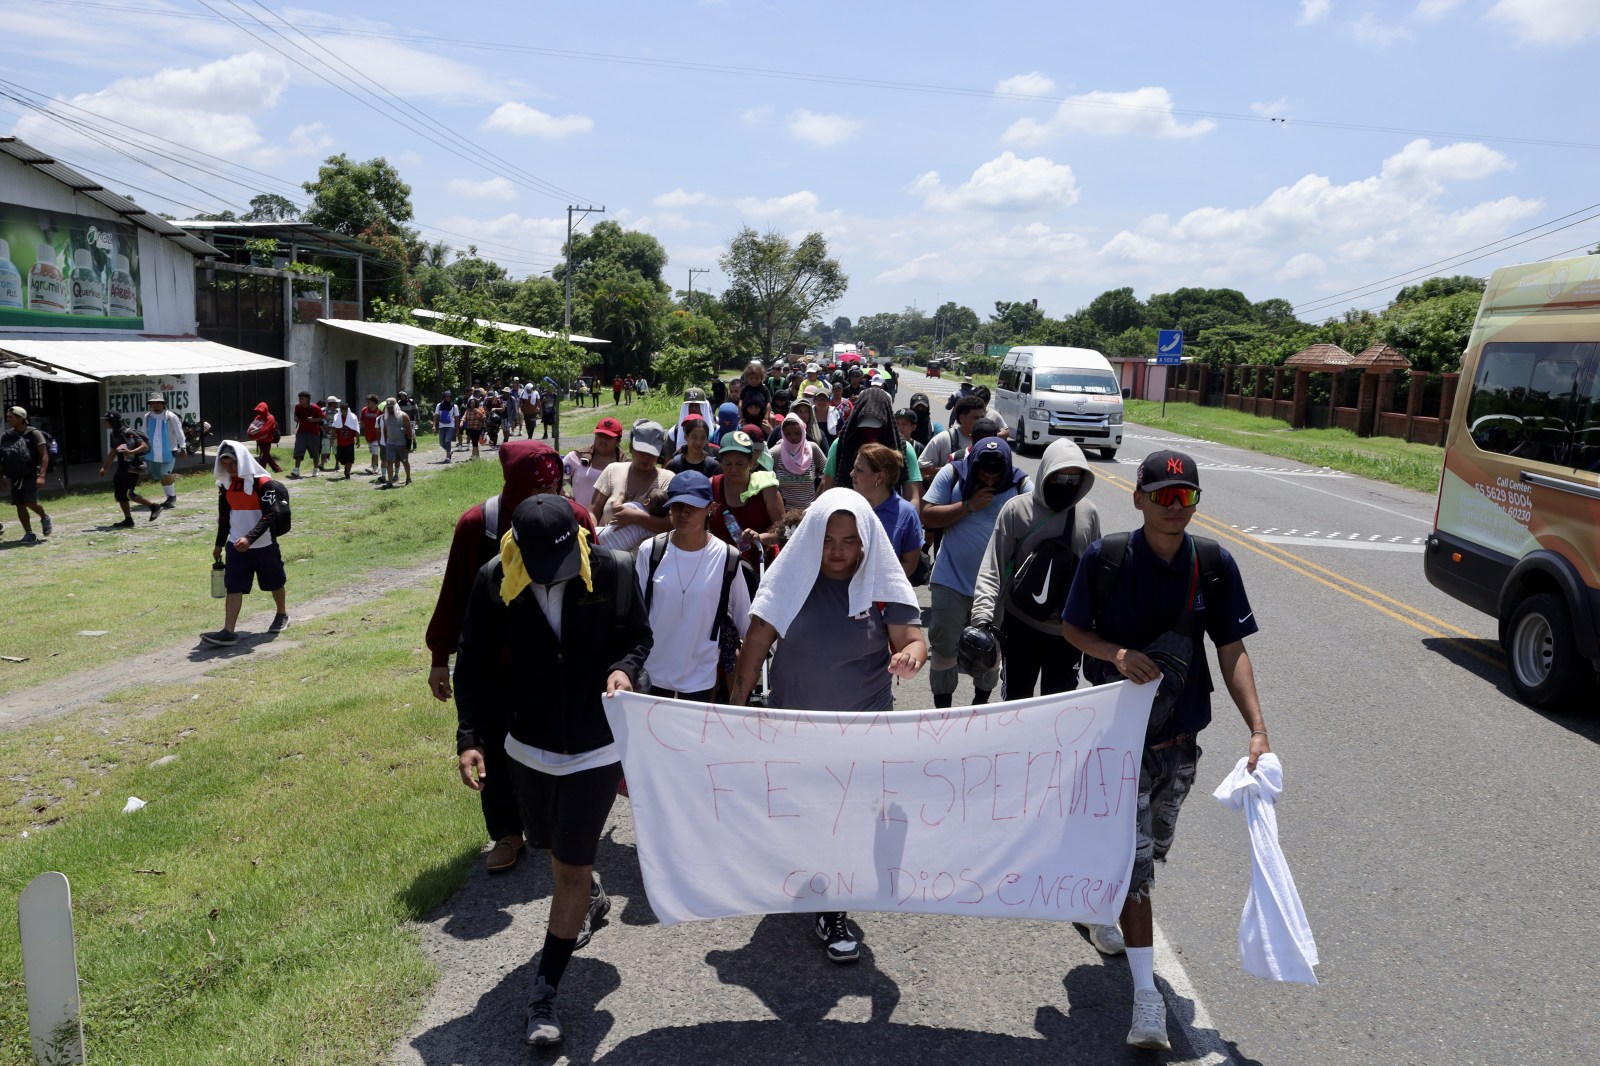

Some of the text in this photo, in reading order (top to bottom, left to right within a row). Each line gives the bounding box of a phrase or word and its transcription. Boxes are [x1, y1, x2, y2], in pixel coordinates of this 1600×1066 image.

[1167, 457, 1184, 475] NY
[1475, 483, 1485, 496] 55
[1486, 485, 1507, 502] 5629
[1508, 491, 1533, 509] 8004
[1497, 477, 1532, 493] Call Center:
[1508, 507, 1531, 522] 60230
[823, 761, 856, 836] Y
[783, 868, 855, 900] CON
